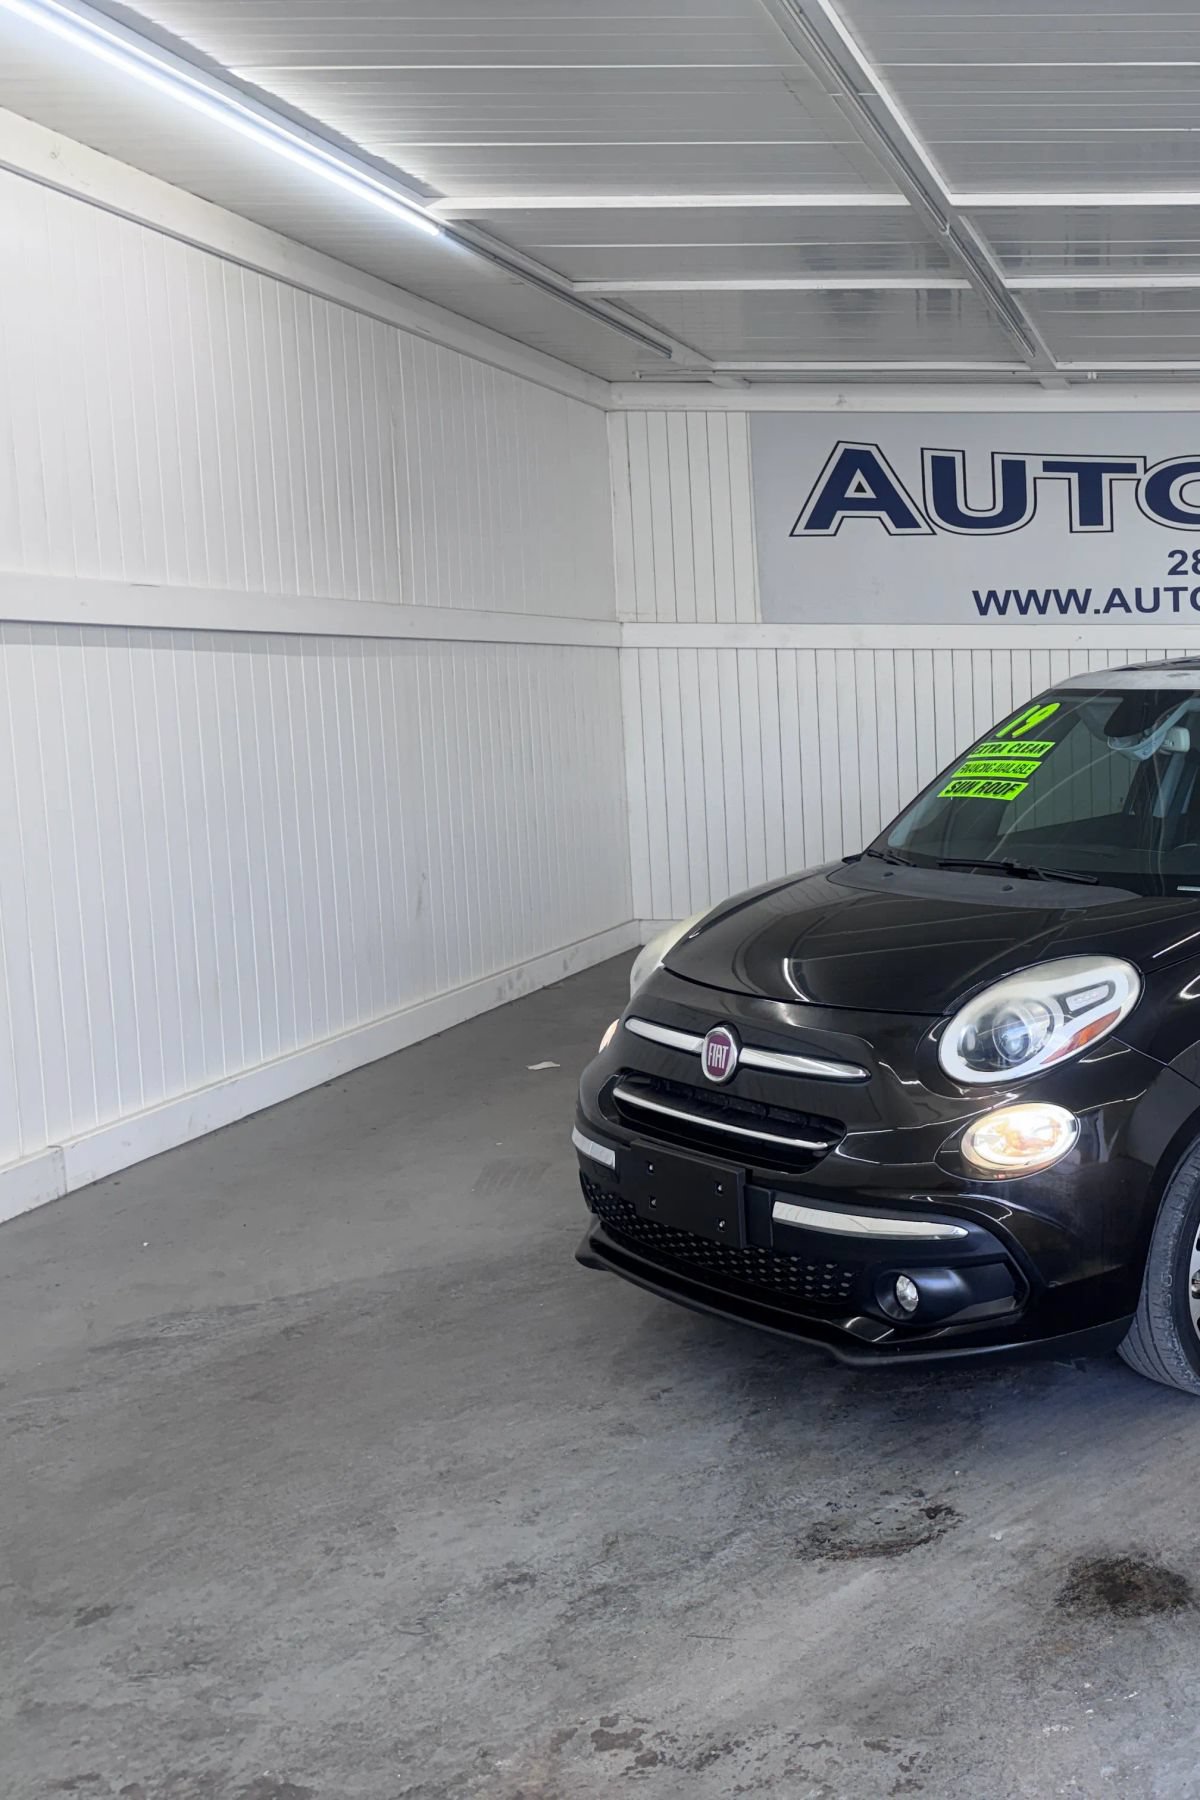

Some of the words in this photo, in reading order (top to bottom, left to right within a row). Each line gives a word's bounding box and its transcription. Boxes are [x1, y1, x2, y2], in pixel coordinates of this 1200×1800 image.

[995, 702, 1061, 739] 19
[973, 743, 1009, 755] EXTRA
[1007, 742, 1050, 754] CLEAN
[945, 780, 981, 794] SUN
[974, 782, 1022, 796] ROOF
[707, 1042, 729, 1070] FIAT
